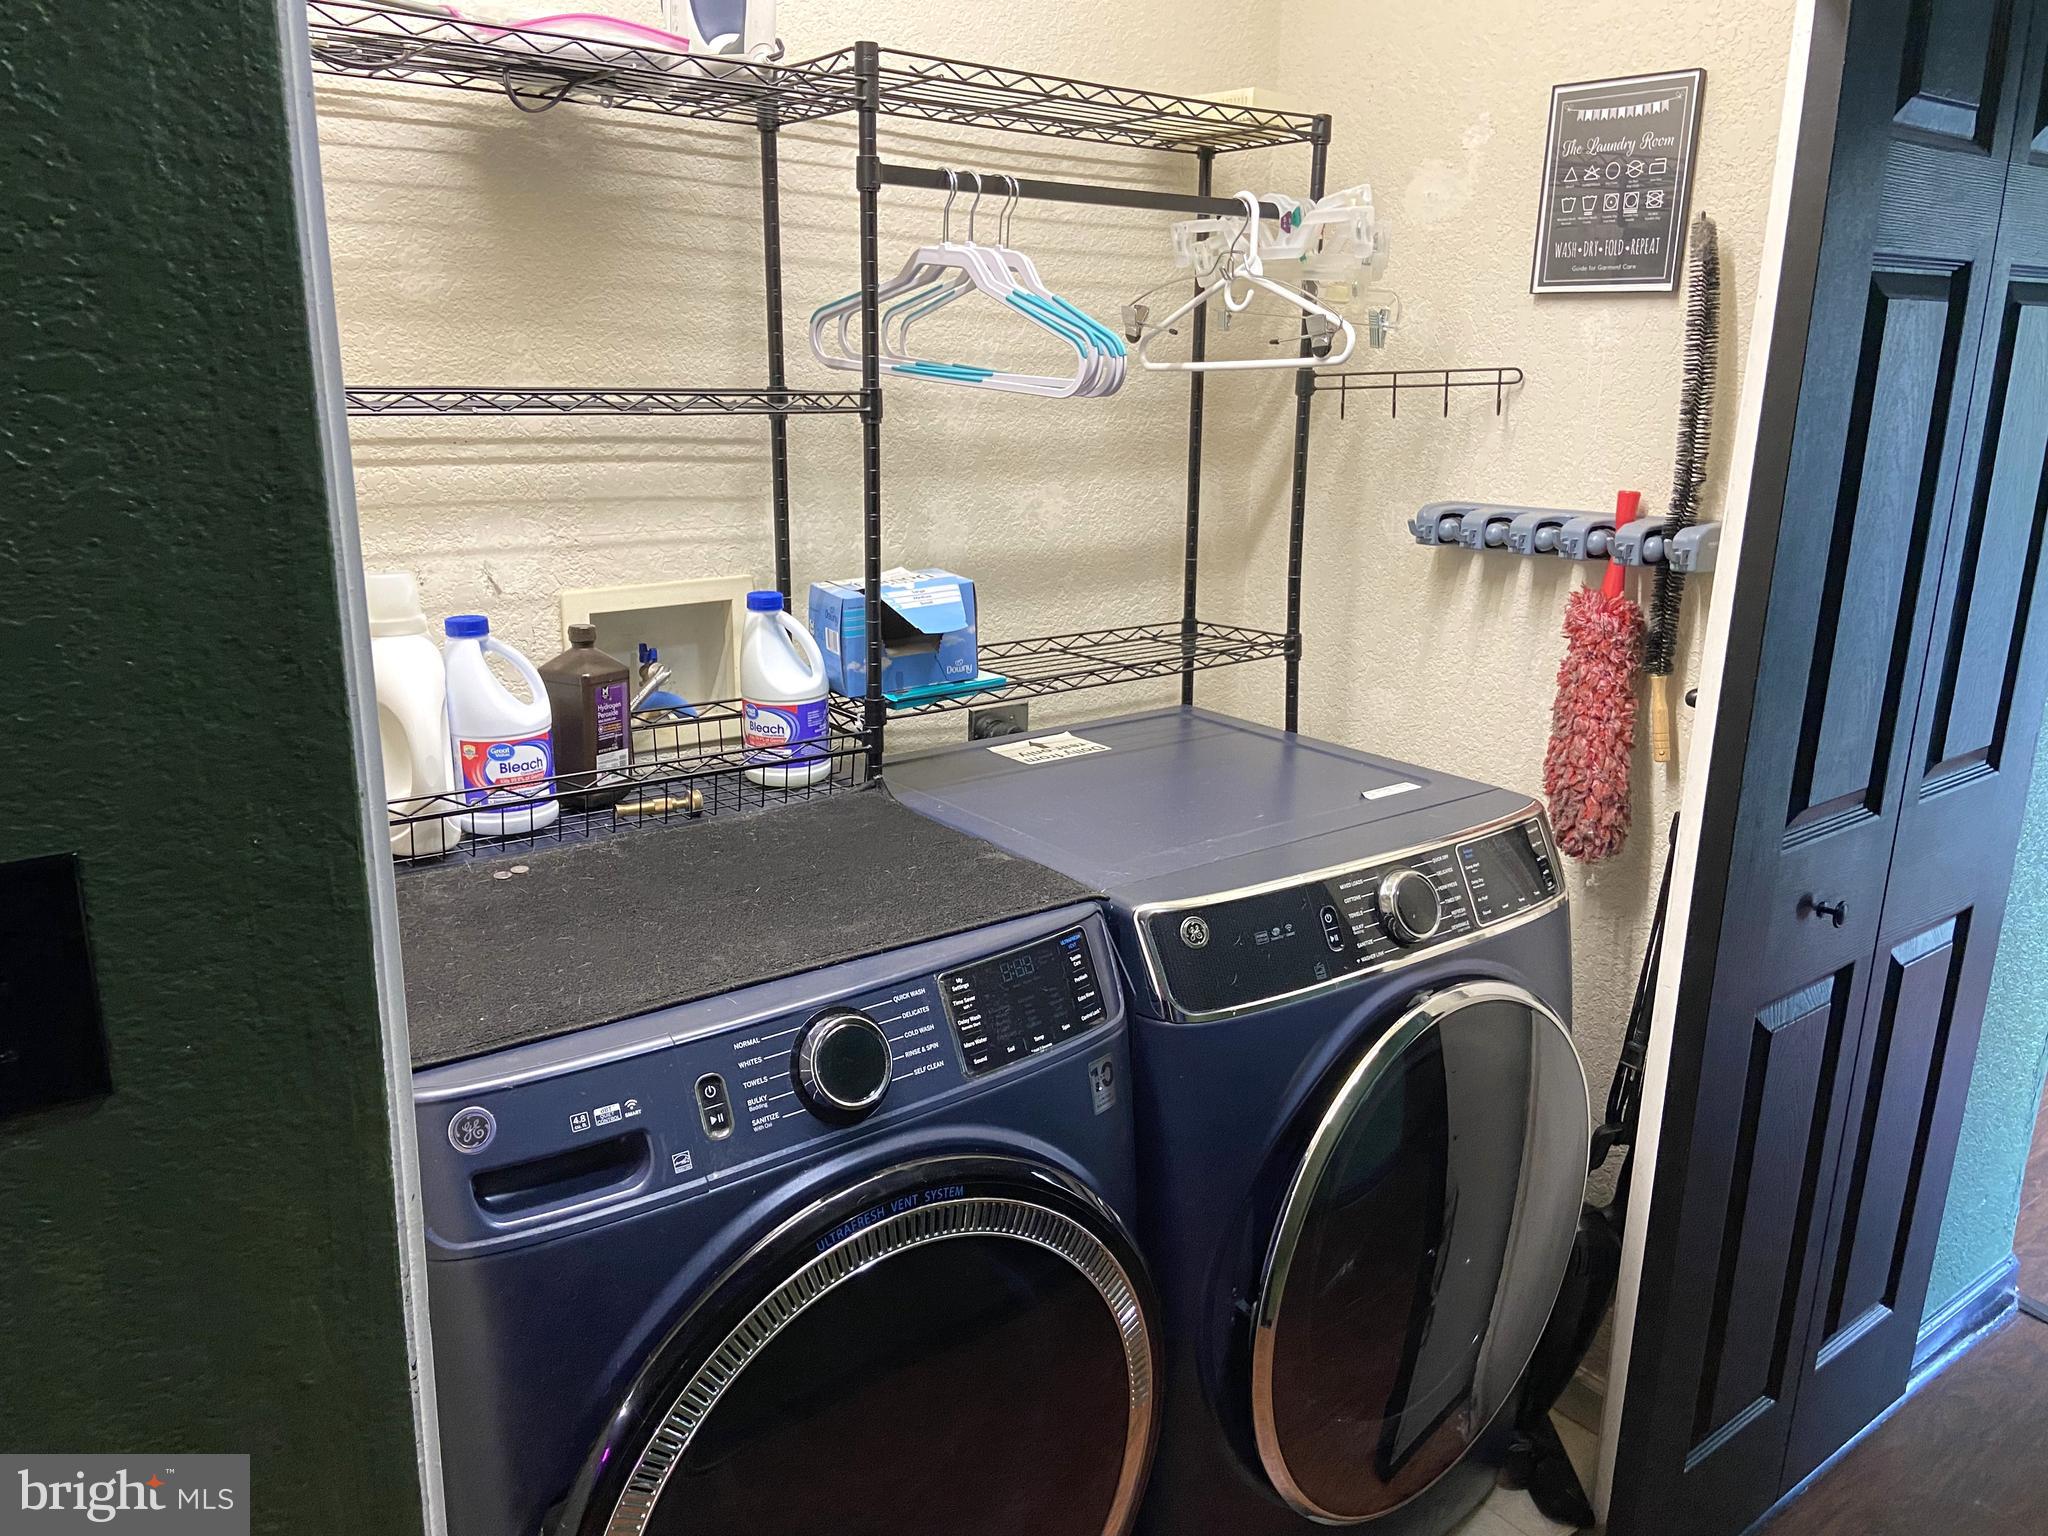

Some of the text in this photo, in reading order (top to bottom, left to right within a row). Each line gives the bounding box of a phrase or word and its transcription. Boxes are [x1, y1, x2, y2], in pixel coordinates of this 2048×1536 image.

[1562, 131, 1675, 157] The Laundry Room
[1555, 237, 1661, 258] WASH DRY FOLD REPEAT
[1571, 264, 1588, 272] Guide
[946, 664, 973, 675] Downy
[597, 702, 622, 712] Hydrogen
[597, 710, 619, 719] Peroxide
[749, 720, 785, 734] Bleach
[499, 757, 543, 774] Bleach
[892, 988, 926, 1004] QUICK WASH
[901, 1006, 930, 1019] DELICATES
[903, 1023, 935, 1039] COLD WASH
[733, 1037, 761, 1050] NORMAL
[904, 1048, 920, 1059] RINSE
[926, 1042, 939, 1052] SPIN
[738, 1056, 763, 1069] WHITES
[913, 1060, 945, 1077] SELF CLEAN
[742, 1076, 768, 1089] TOWELS
[747, 1094, 769, 1107] BULKY
[573, 1114, 587, 1124] 4.8
[625, 1109, 642, 1118] SMART
[751, 1111, 780, 1127] SANITIZE
[816, 1185, 964, 1251] ULTRAFRESH VENT SYSTEM
